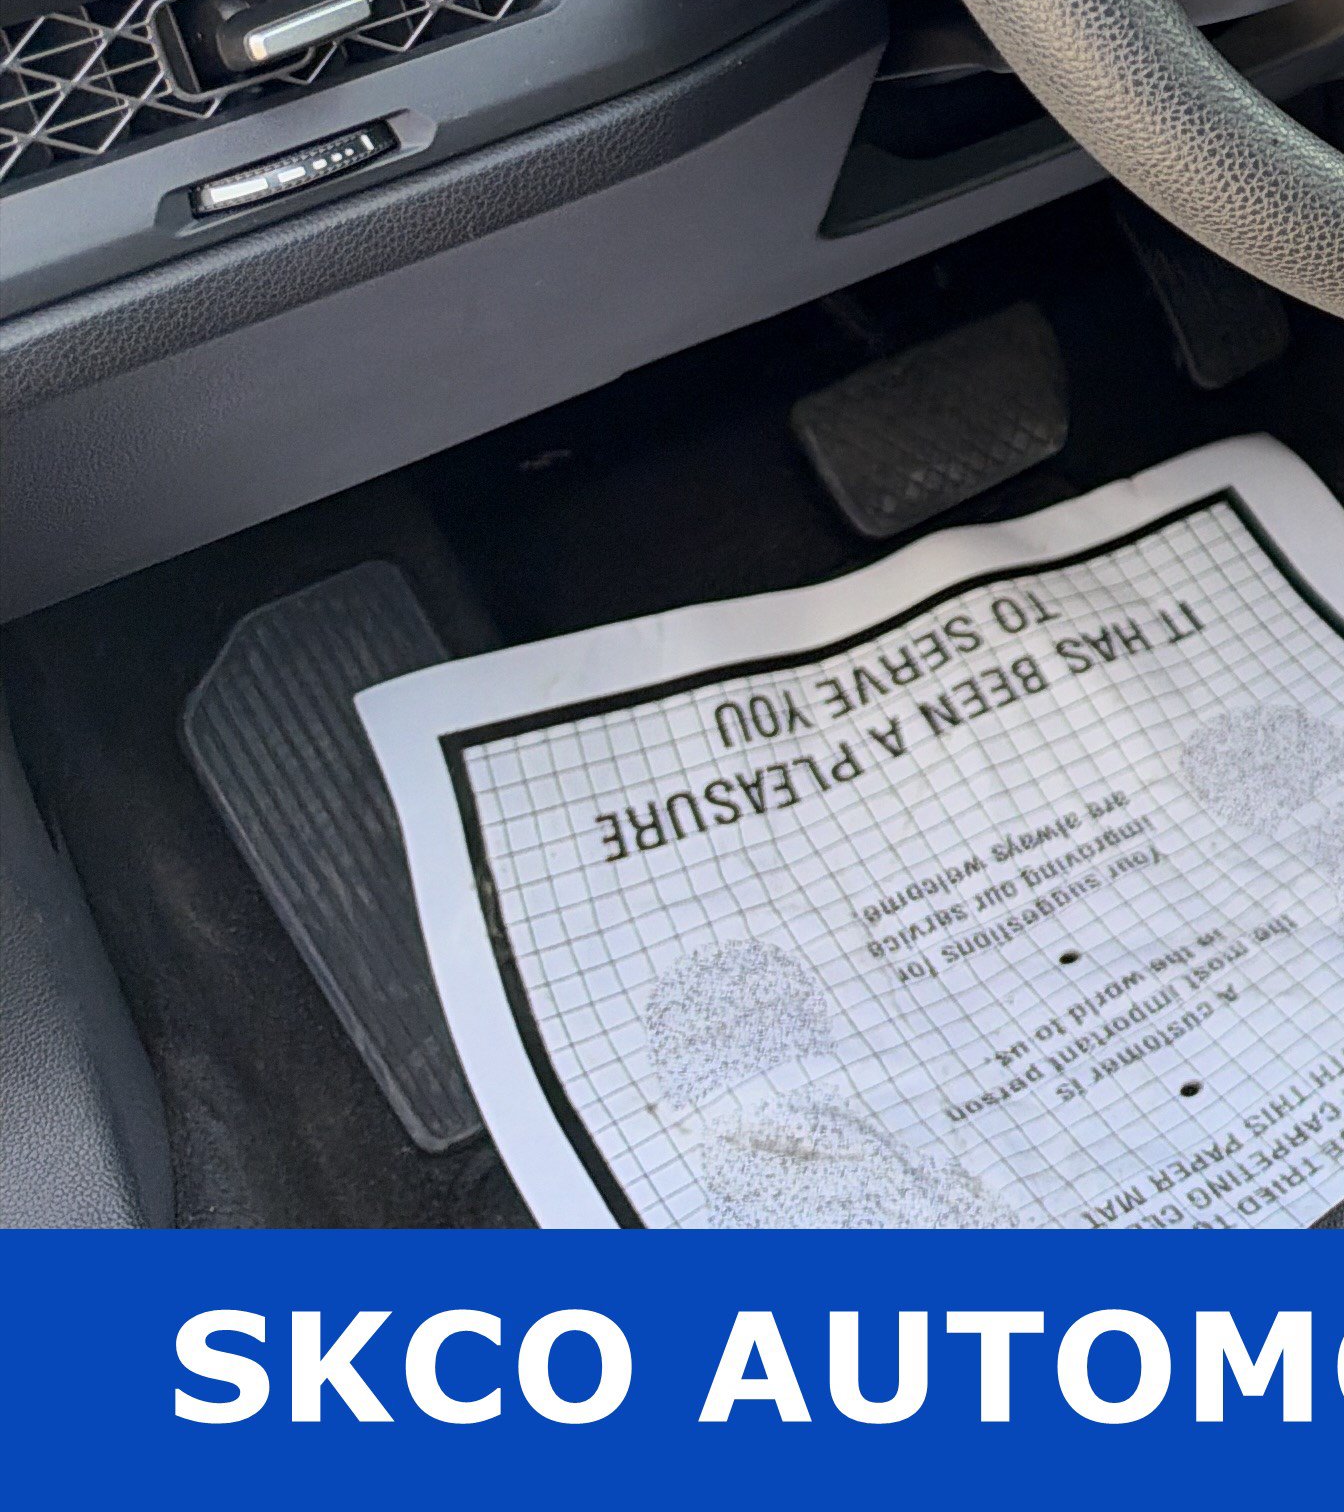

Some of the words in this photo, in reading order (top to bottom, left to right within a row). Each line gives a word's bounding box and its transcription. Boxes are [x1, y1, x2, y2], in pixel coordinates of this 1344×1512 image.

[991, 591, 1061, 634] TO
[1157, 599, 1207, 644] IT
[815, 615, 985, 720] SERVE
[1056, 617, 1153, 675] HAS
[714, 690, 816, 748] YOU
[918, 654, 1052, 737] BEEN
[867, 714, 909, 759] A
[595, 740, 865, 863] PLEASURE
[1086, 790, 1131, 820] are
[990, 811, 1083, 863] always
[1020, 814, 1157, 890] improving
[1107, 844, 1165, 881] Your
[940, 872, 1103, 965] suggestions
[973, 879, 1018, 912] our
[867, 903, 970, 960] service
[1197, 928, 1225, 948] in
[1253, 913, 1299, 942] the
[897, 953, 940, 985] for
[1150, 946, 1195, 973] the
[1184, 939, 1249, 990] most
[1067, 970, 1146, 1027] world
[1216, 982, 1240, 1004] A
[1034, 1016, 1068, 1043] to
[1049, 982, 1184, 1074] important
[1090, 999, 1216, 1084] customer
[944, 1063, 1046, 1124] person
[1056, 1078, 1088, 1104] is
[1242, 1085, 1309, 1139] THIS
[1147, 1132, 1245, 1195] PAPER
[1185, 1100, 1343, 1212] CARPETING
[1080, 1184, 1149, 1229] MAT
[1236, 1155, 1326, 1217] TRIED
